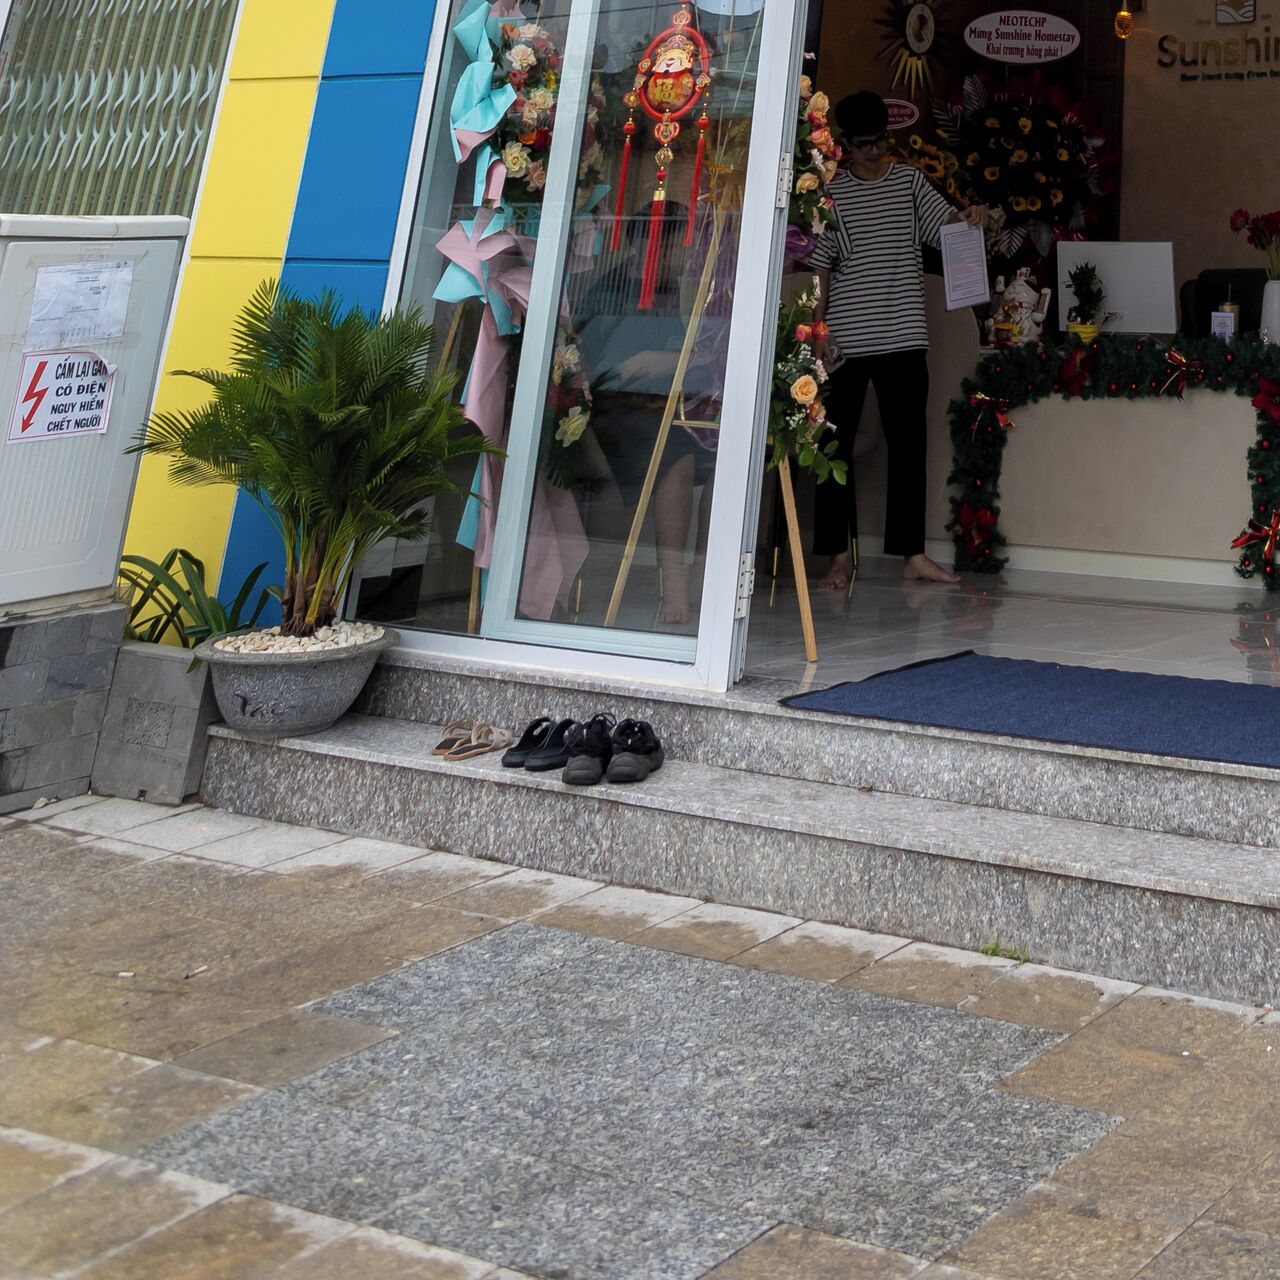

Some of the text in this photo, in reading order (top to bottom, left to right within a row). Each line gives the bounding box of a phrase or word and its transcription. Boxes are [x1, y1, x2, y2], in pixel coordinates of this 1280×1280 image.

[999, 15, 1048, 28] NEOTECHP
[995, 26, 1033, 42] Sunshine
[1034, 29, 1077, 45] Homestay
[55, 356, 73, 381] CẤM
[75, 361, 90, 383] LẠI
[55, 381, 107, 397] CÓ ĐIỆN
[50, 395, 105, 415] NGUY HIỂM
[47, 415, 101, 433] CHẾT NGƯỜI
